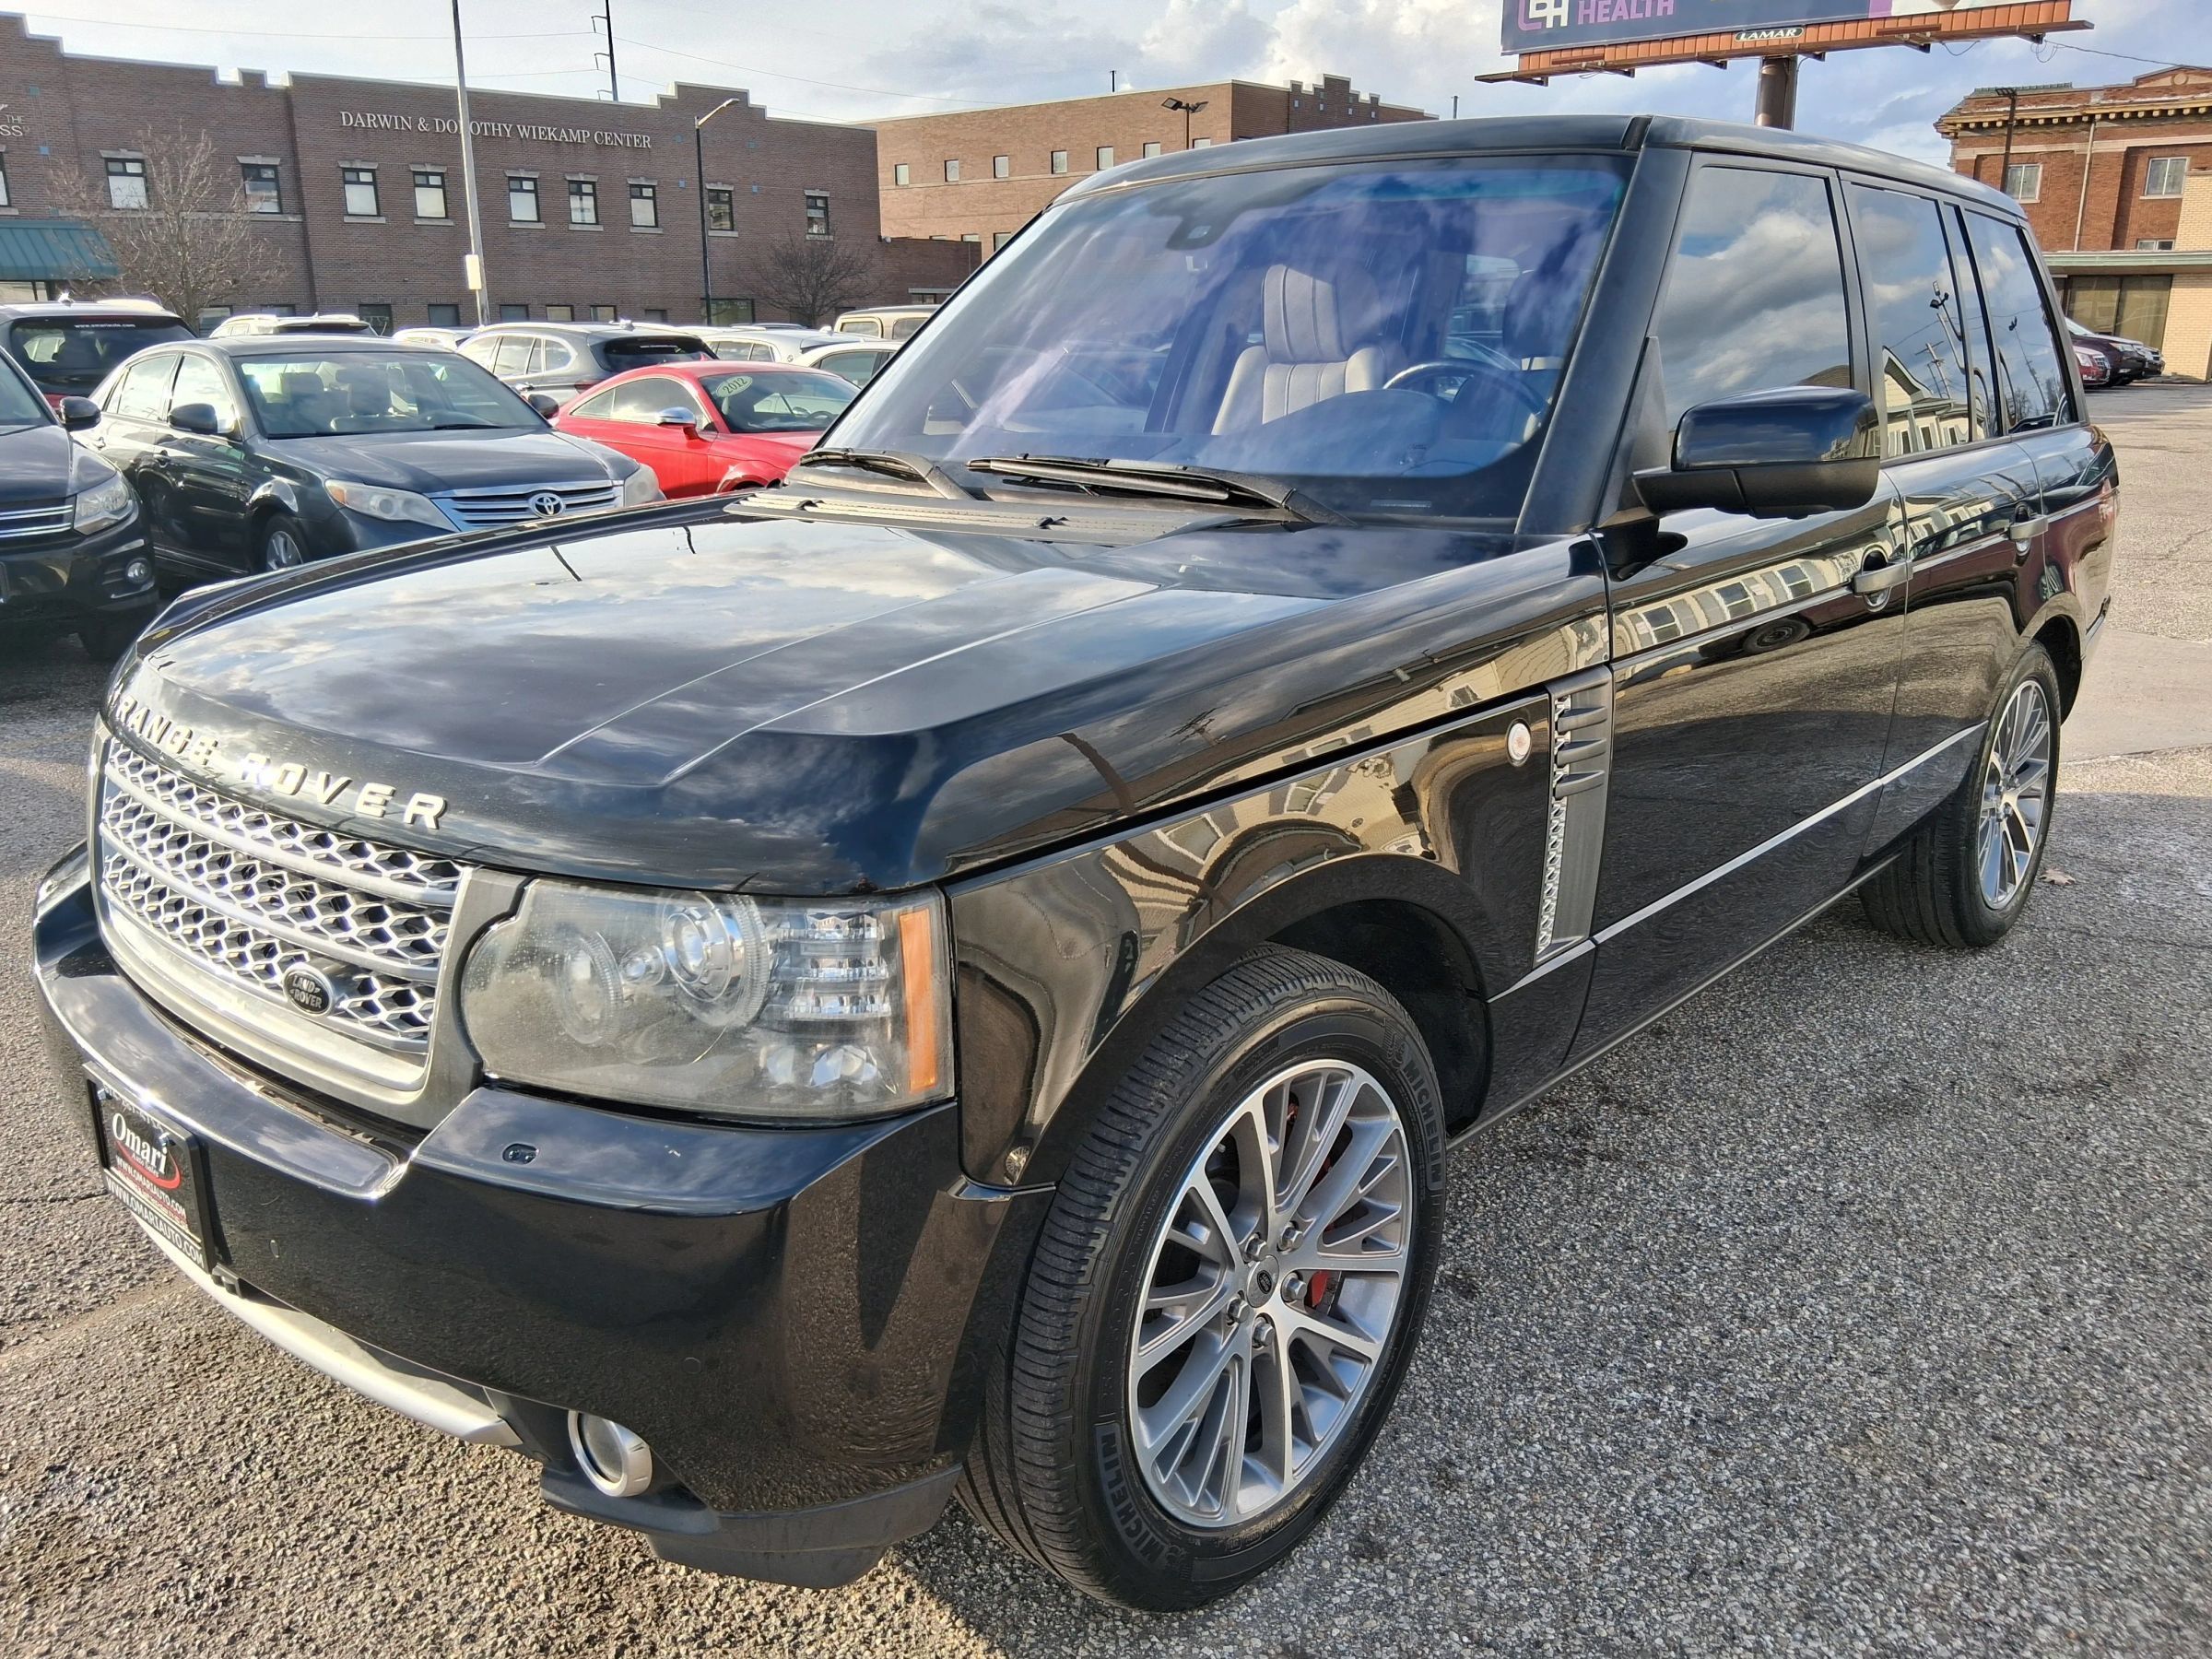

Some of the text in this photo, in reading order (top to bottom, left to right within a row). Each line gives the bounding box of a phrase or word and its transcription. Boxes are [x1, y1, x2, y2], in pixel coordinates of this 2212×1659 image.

[1577, 0, 1674, 25] HEALTH
[1740, 29, 1796, 41] LAMAR
[5, 114, 25, 124] THE
[340, 111, 652, 148] DARWIN & DOOTHY WIEKAMP CENTER
[723, 377, 748, 394] 2012
[238, 751, 449, 830] ROVER
[292, 975, 316, 993] LAND
[294, 988, 323, 1009] ROVER
[1403, 1060, 1442, 1183] MICHELIN
[112, 1112, 168, 1174] Omari
[105, 1174, 205, 1269] WWW.OMARIAUTO.COM
[1100, 1432, 1167, 1566] MICHELIN
